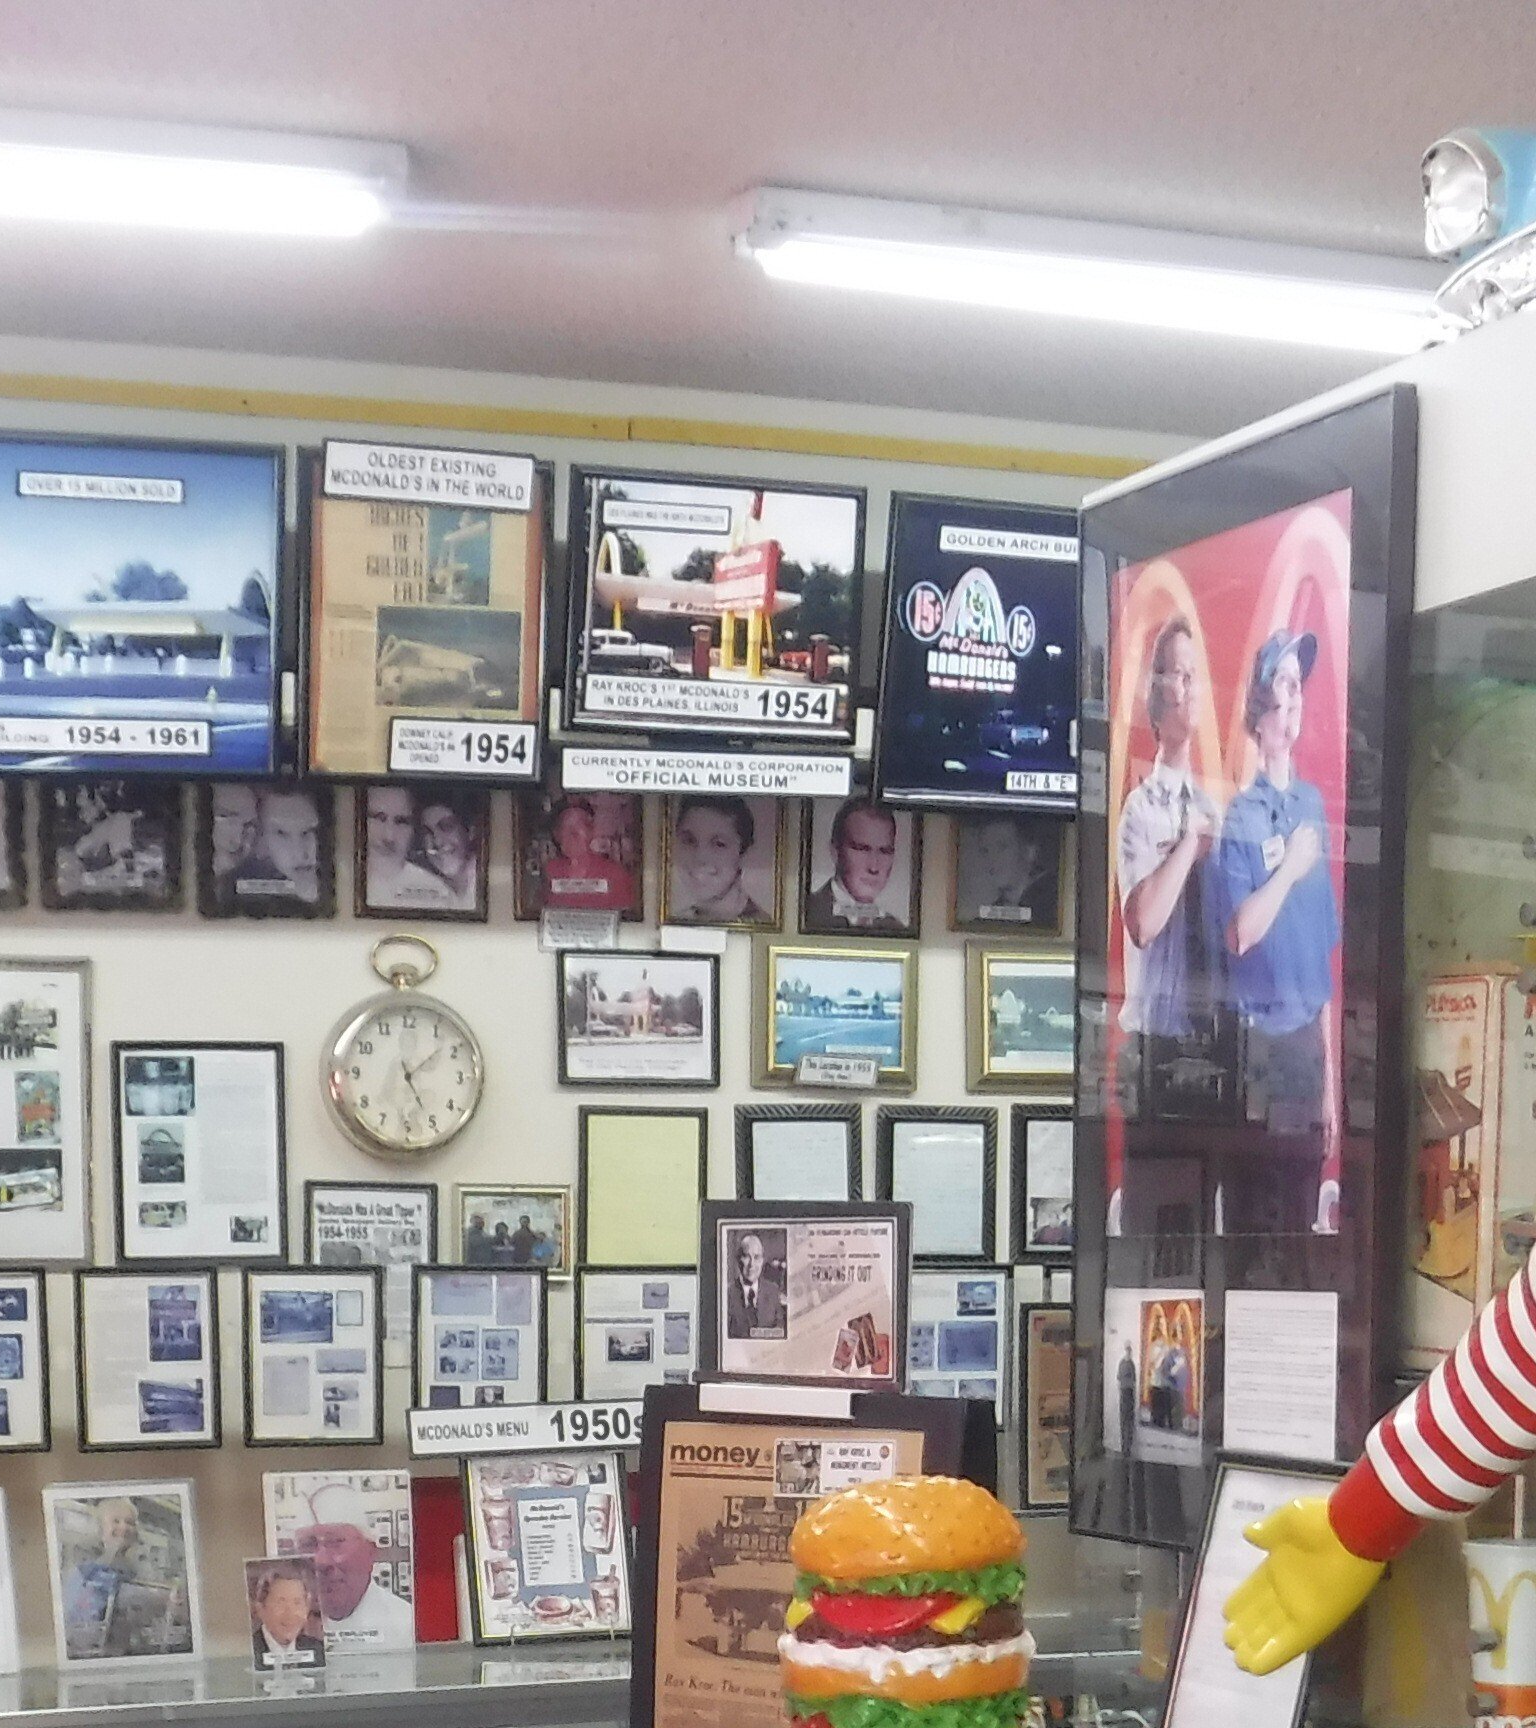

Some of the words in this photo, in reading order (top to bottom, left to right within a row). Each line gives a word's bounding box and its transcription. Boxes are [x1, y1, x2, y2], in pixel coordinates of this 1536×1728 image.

[368, 451, 425, 470] OLDEST
[430, 457, 497, 479] EXISTING
[84, 481, 137, 496] MILLION
[140, 483, 176, 498] SOLD
[426, 476, 440, 492] IN
[445, 478, 470, 496] THE
[474, 482, 525, 501] WORLD
[946, 533, 1006, 549] GOLDEN
[1009, 538, 1049, 552] ARCH
[591, 680, 613, 691] RAY
[678, 686, 750, 699] MCDONALD'S
[604, 696, 614, 705] IN
[617, 696, 639, 707] DES
[693, 702, 739, 713] ILLINOIS
[757, 689, 828, 720] 1954
[64, 726, 122, 745] 1954
[146, 727, 201, 747] 1961
[461, 732, 527, 764] 1954
[571, 755, 651, 768] CURRENTLY
[655, 758, 745, 771] MCDONALD'S
[748, 760, 844, 774] CORPORATION
[1010, 774, 1037, 789] 14TH
[378, 1022, 390, 1035] 11
[402, 1015, 416, 1028] 12
[1524, 1025, 1534, 1037] A
[358, 1041, 373, 1055] 10
[450, 1045, 458, 1059] 2
[351, 1066, 360, 1079] 9
[457, 1070, 464, 1085] 3
[359, 1095, 369, 1109] 8
[445, 1098, 454, 1111] 4
[378, 1112, 387, 1126] 7
[428, 1114, 437, 1129] 5
[416, 1422, 494, 1441] MCDONALD'S
[495, 1421, 530, 1437] MENU
[669, 1443, 761, 1469] money
